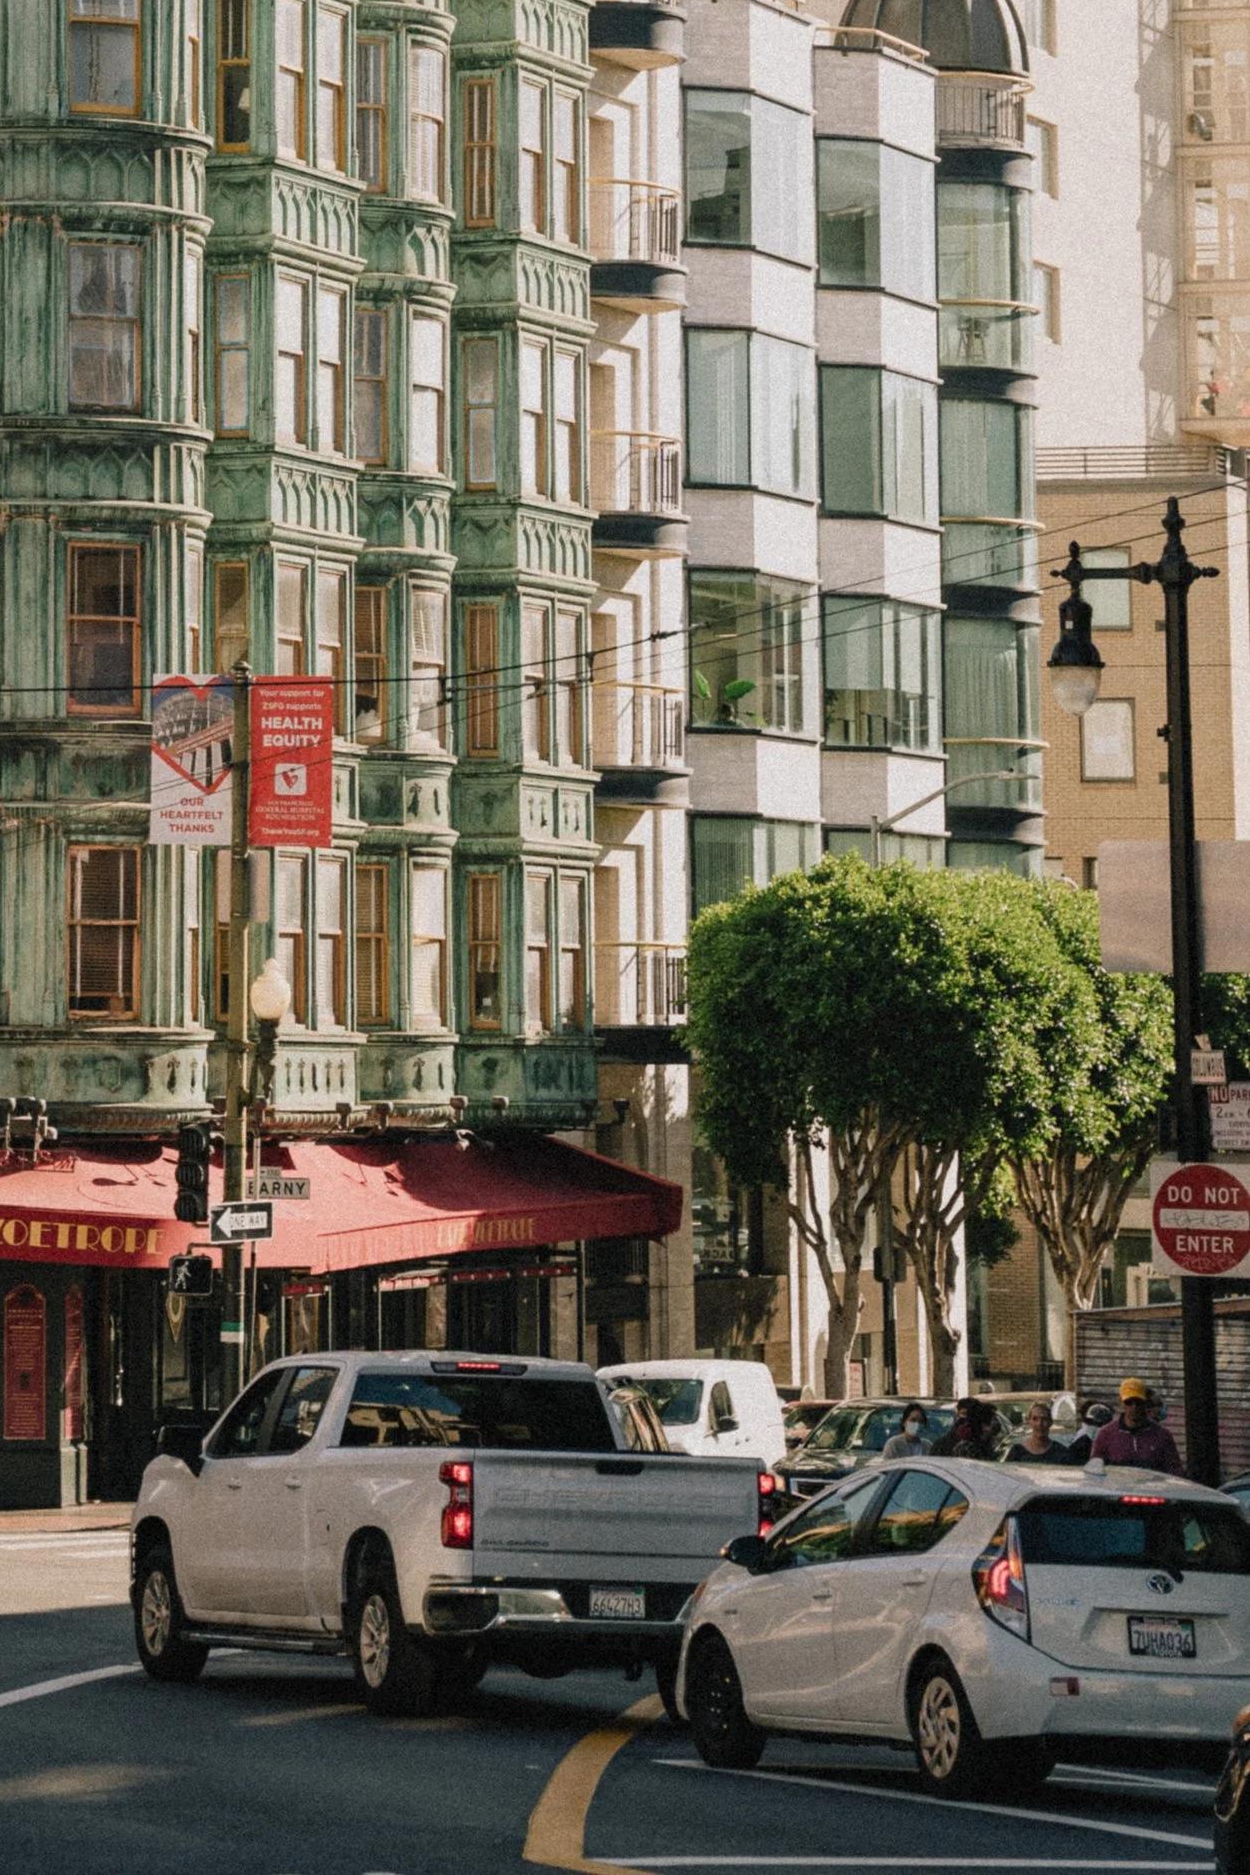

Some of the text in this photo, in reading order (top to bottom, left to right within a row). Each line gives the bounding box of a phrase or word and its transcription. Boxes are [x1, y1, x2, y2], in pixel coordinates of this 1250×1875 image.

[261, 716, 323, 730] HEALTH
[262, 734, 322, 747] EQUITY
[180, 797, 204, 806] OUR
[160, 810, 224, 820] HEARTFELT
[169, 824, 215, 833] THANKS
[1211, 1086, 1229, 1103] NO
[248, 1181, 306, 1195] EARNY
[1167, 1186, 1240, 1204] DO NOT
[1175, 1235, 1234, 1253] ENTER
